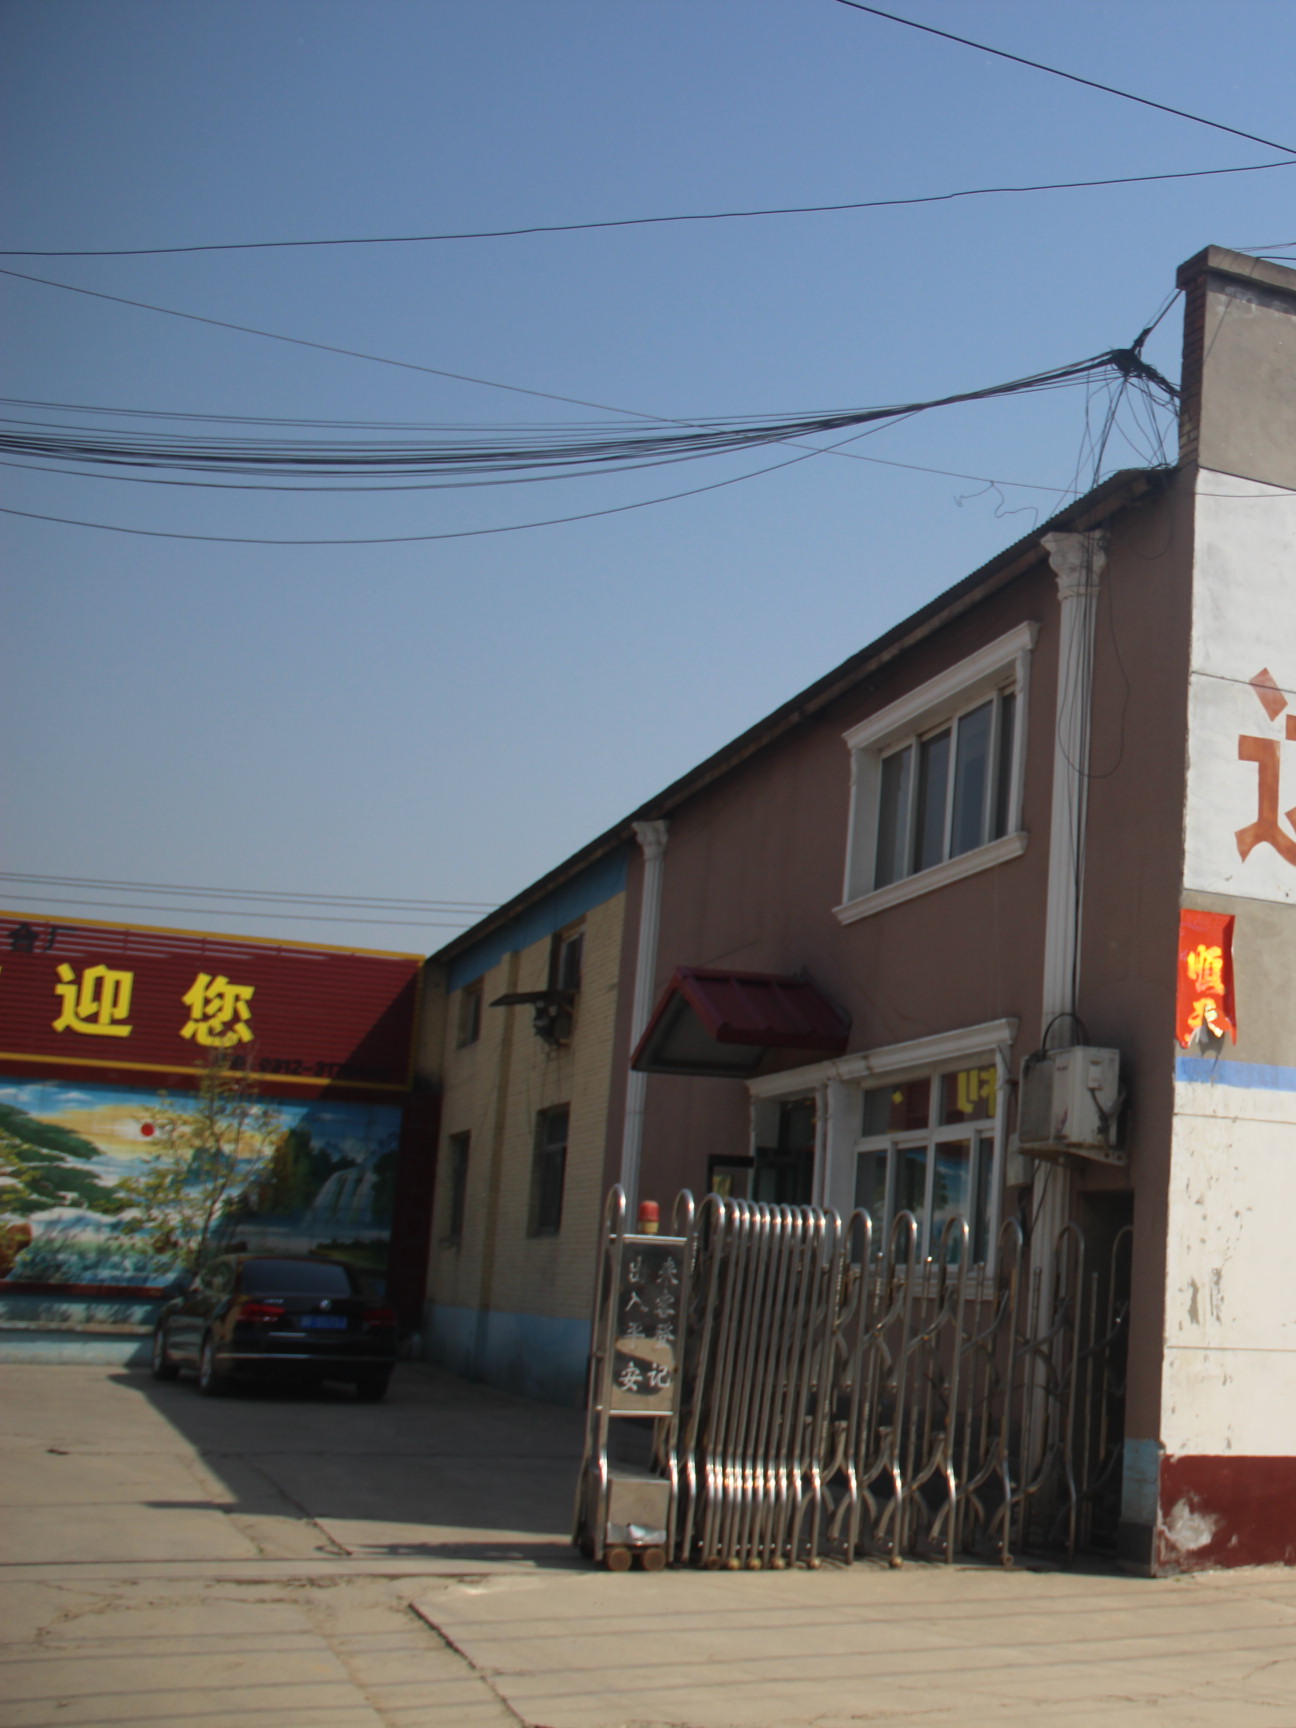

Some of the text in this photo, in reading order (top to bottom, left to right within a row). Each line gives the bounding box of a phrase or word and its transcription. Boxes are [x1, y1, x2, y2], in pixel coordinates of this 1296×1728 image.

[0, 963, 255, 1046] 迎您
[619, 1256, 649, 1391] 出入平安
[647, 1256, 679, 1388] 来客登记
